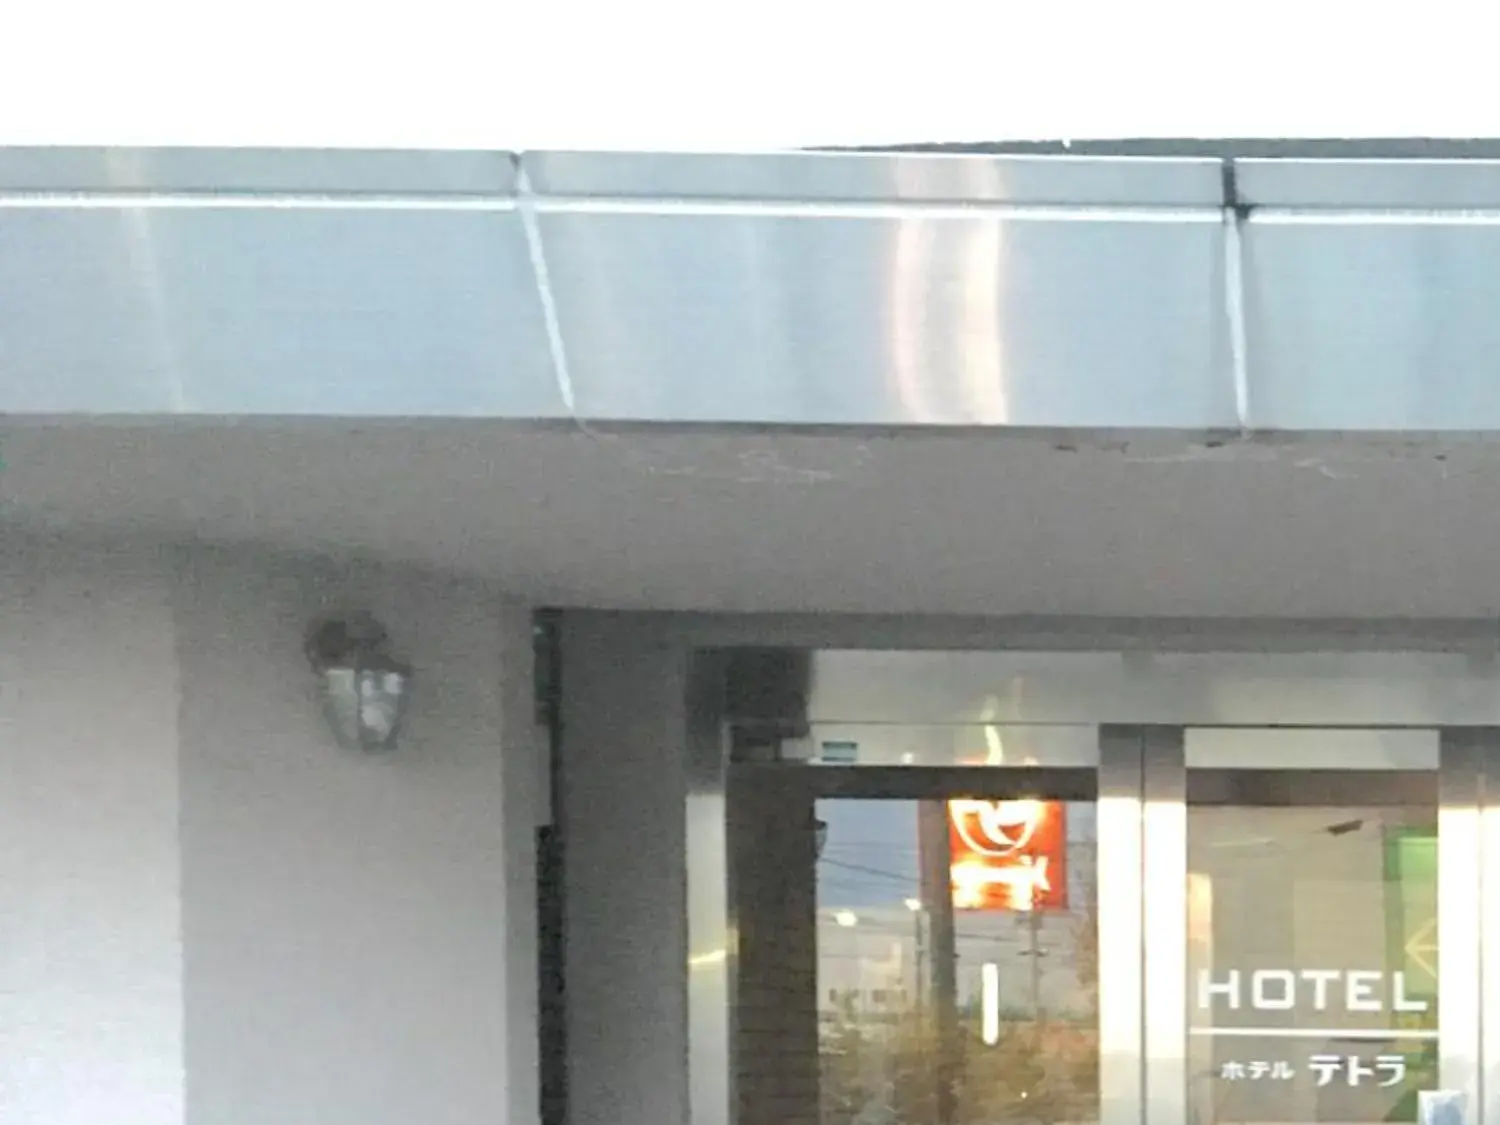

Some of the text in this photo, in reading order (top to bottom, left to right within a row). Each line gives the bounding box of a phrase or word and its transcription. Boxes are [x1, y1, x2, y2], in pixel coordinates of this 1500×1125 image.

[1197, 969, 1429, 1012] HOTEL
[1220, 1054, 1406, 1088] ホテル テトラ
